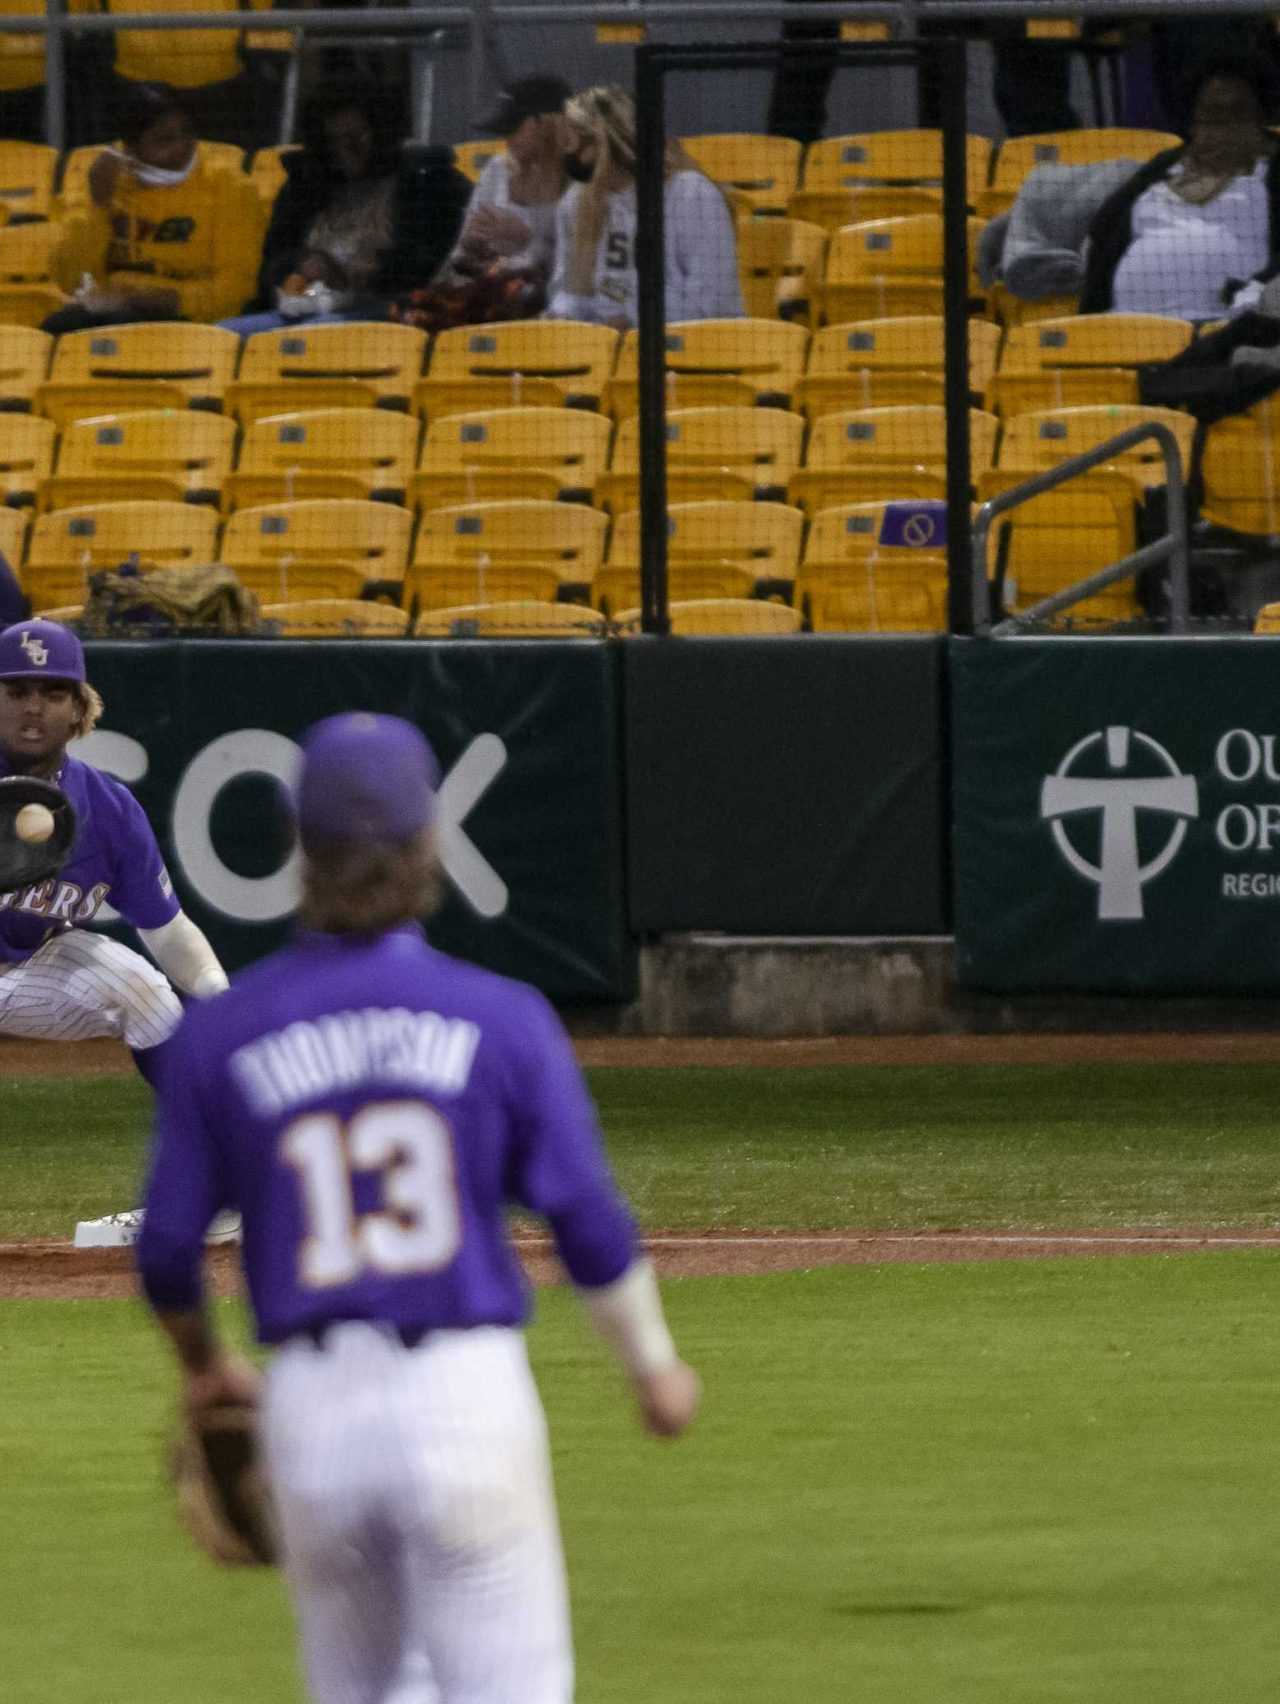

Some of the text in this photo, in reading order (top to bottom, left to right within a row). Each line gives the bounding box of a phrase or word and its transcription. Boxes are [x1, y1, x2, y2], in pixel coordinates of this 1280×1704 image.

[21, 631, 49, 666] LSU
[1222, 872, 1280, 896] REGI
[229, 1006, 481, 1118] THOMPSON
[280, 1098, 464, 1286] 13
